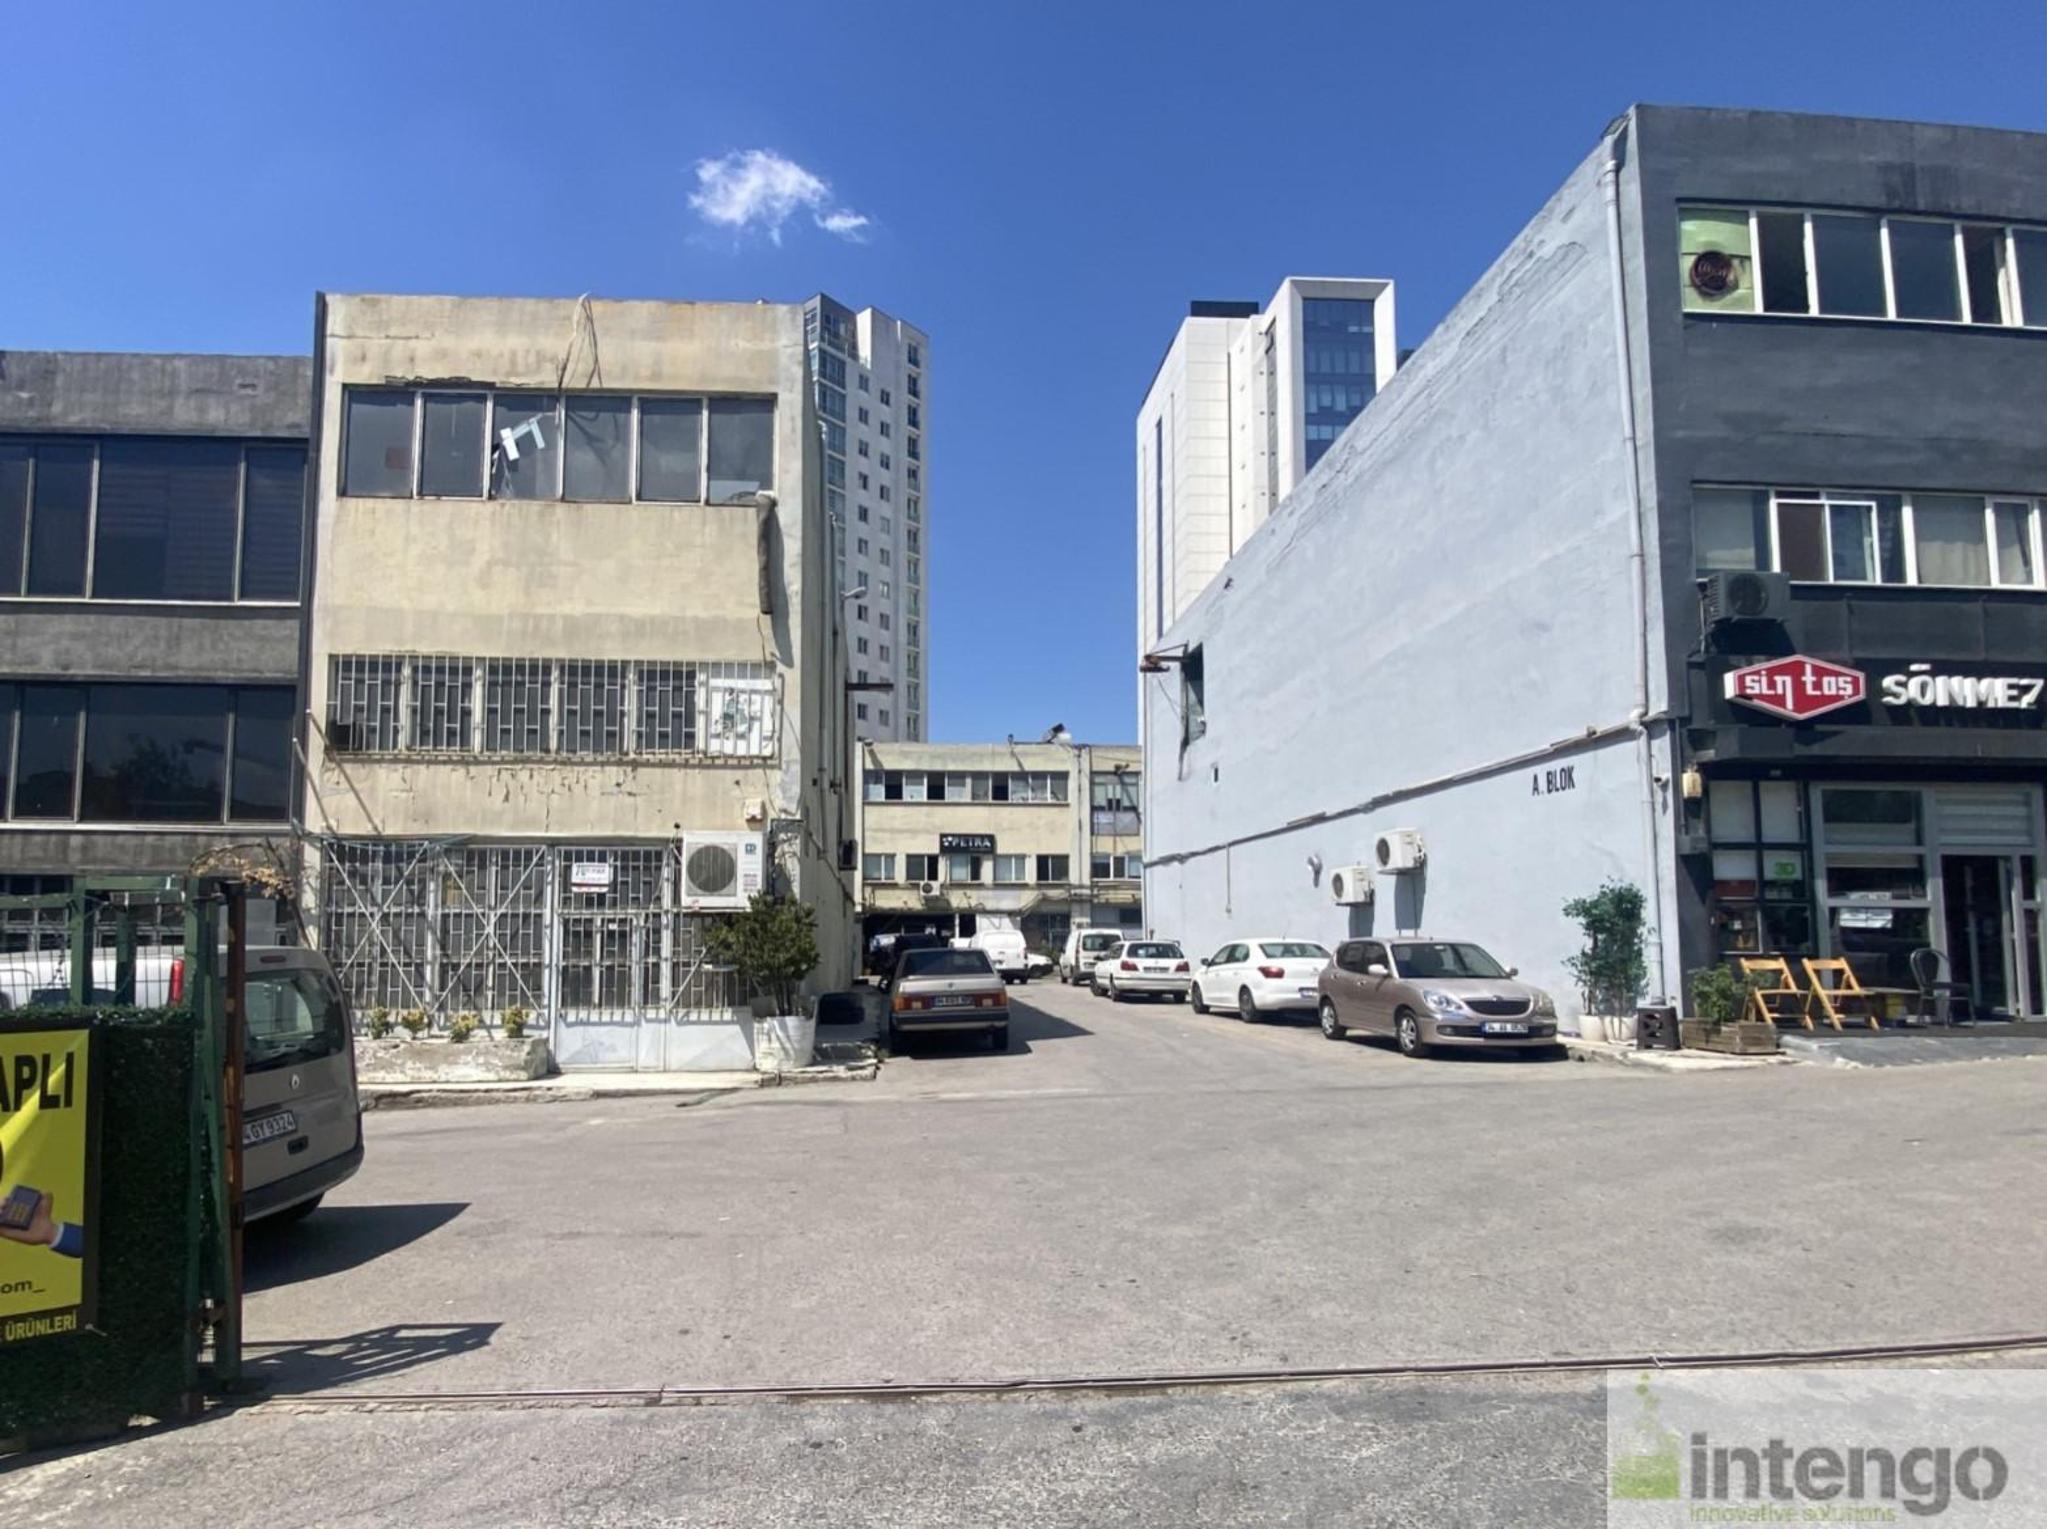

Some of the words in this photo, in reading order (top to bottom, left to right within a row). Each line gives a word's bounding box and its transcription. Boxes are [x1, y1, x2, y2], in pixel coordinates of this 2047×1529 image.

[1546, 765, 1575, 794] BLOK
[952, 837, 991, 847] PETRA
[5, 1309, 77, 1341] ÜRÜNLERİ
